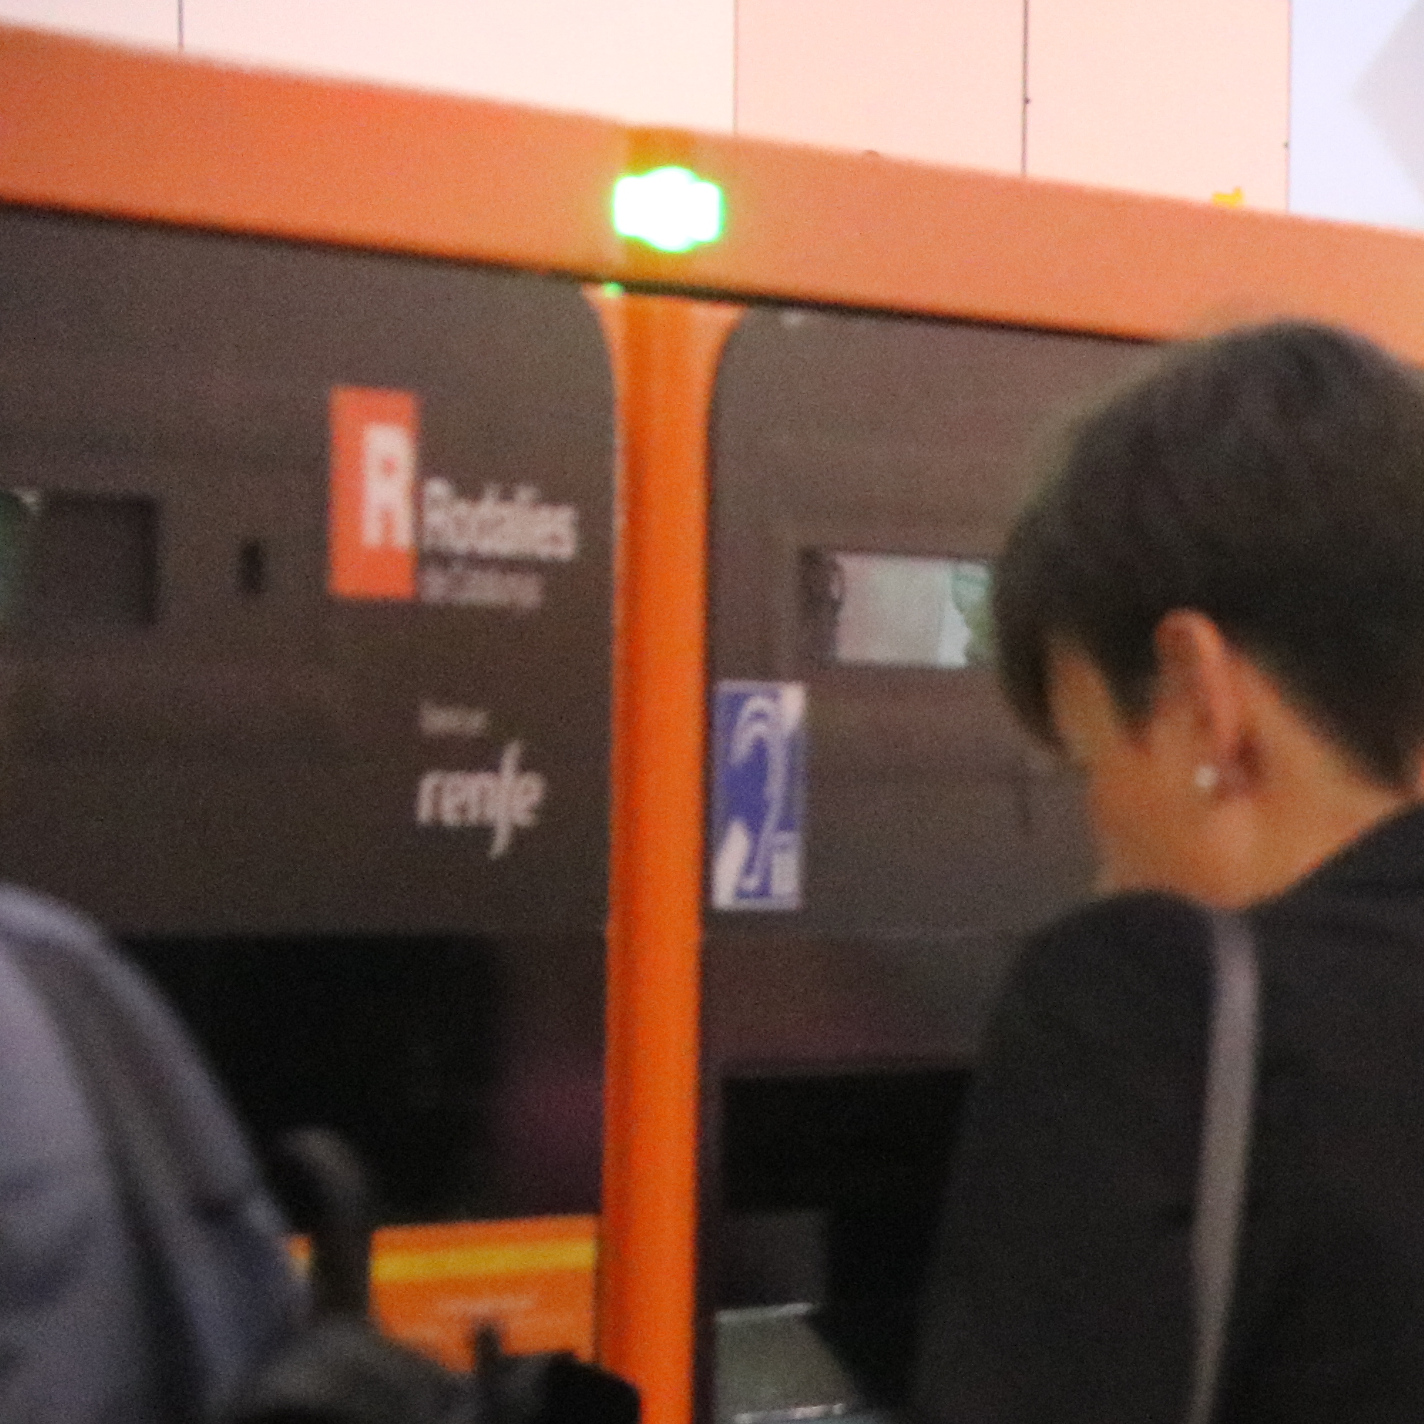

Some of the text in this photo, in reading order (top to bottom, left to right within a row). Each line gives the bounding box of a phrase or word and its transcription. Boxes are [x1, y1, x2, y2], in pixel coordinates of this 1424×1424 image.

[362, 424, 413, 547] R
[423, 478, 577, 562] Rodalies
[416, 740, 546, 860] renfe
